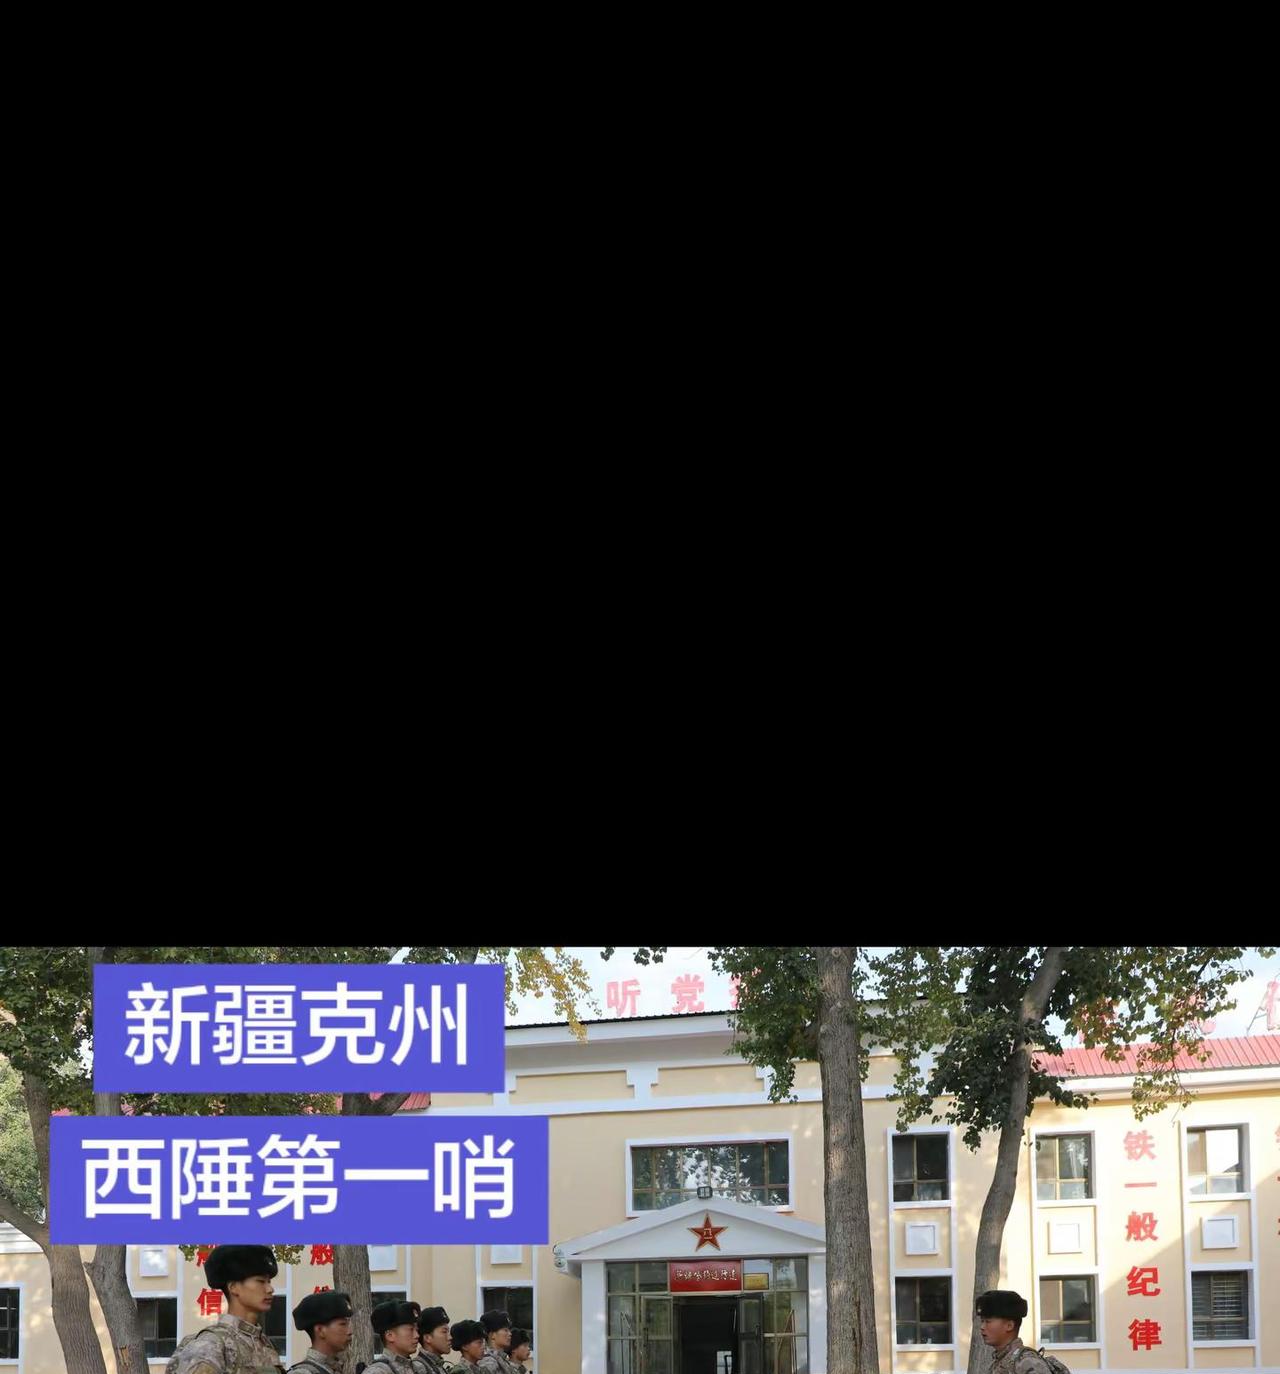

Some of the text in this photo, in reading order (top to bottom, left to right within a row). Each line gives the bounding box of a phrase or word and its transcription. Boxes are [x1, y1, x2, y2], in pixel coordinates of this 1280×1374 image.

[1123, 1129, 1162, 1351] 铁一般纪律
